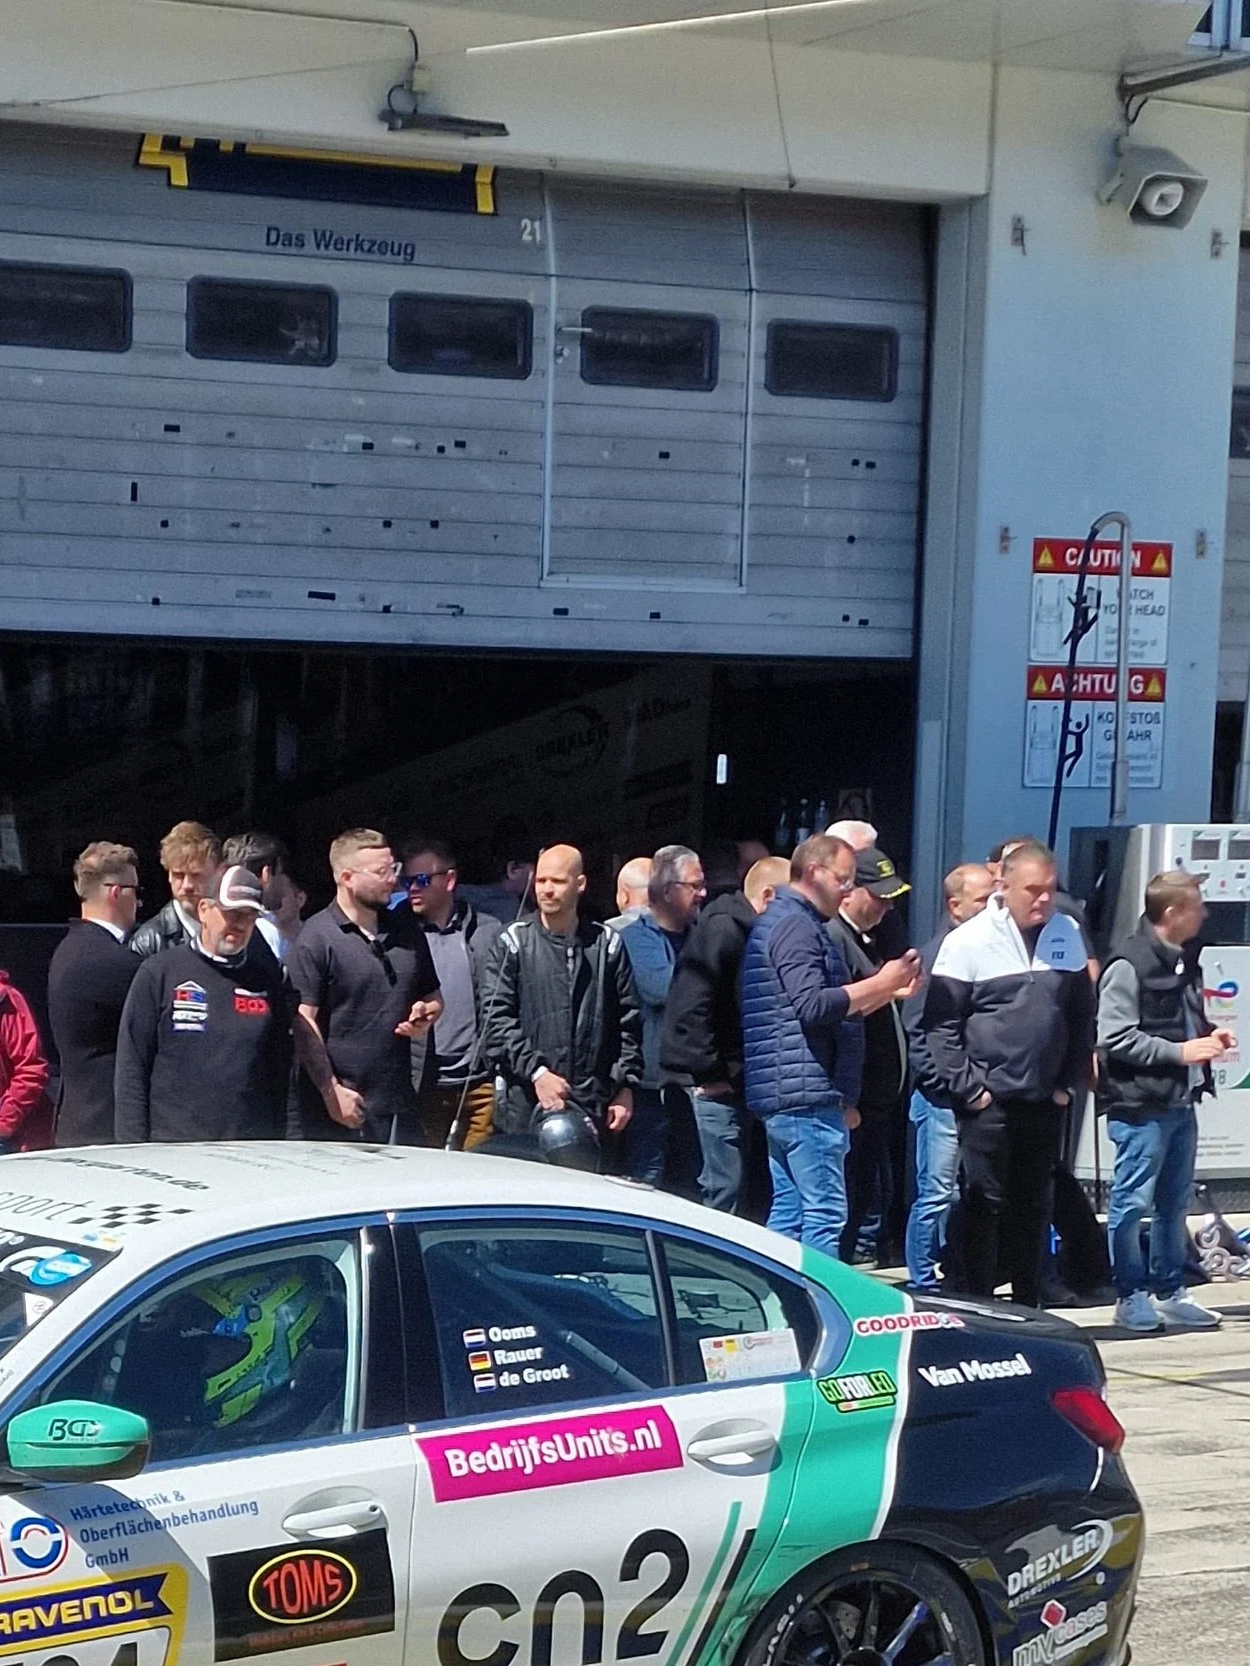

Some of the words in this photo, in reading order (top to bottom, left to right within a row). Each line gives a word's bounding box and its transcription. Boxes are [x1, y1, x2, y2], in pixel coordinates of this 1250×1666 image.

[265, 226, 306, 248] Das
[313, 228, 416, 261] Werkzeug
[520, 218, 541, 244] 21
[1135, 604, 1166, 616] HEAD
[1051, 673, 1144, 694] AHTUG
[1097, 711, 1161, 725] KOSTOß
[1104, 728, 1152, 743] GAHR
[488, 1323, 537, 1343] Ooms
[494, 1346, 544, 1366] Rauer
[500, 1371, 521, 1388] de
[523, 1364, 570, 1385] Groot
[918, 1365, 964, 1388] Van
[958, 1353, 1032, 1383] Mossel
[444, 1418, 662, 1478] BedrijfsUnits.nl
[70, 1493, 171, 1522] Härtetechnik
[173, 1489, 186, 1503] &
[80, 1500, 259, 1544] Oberflächenbehandlung
[85, 1548, 130, 1570] GmbH
[1007, 1528, 1100, 1597] DREXLER
[262, 1559, 344, 1616] TOMS
